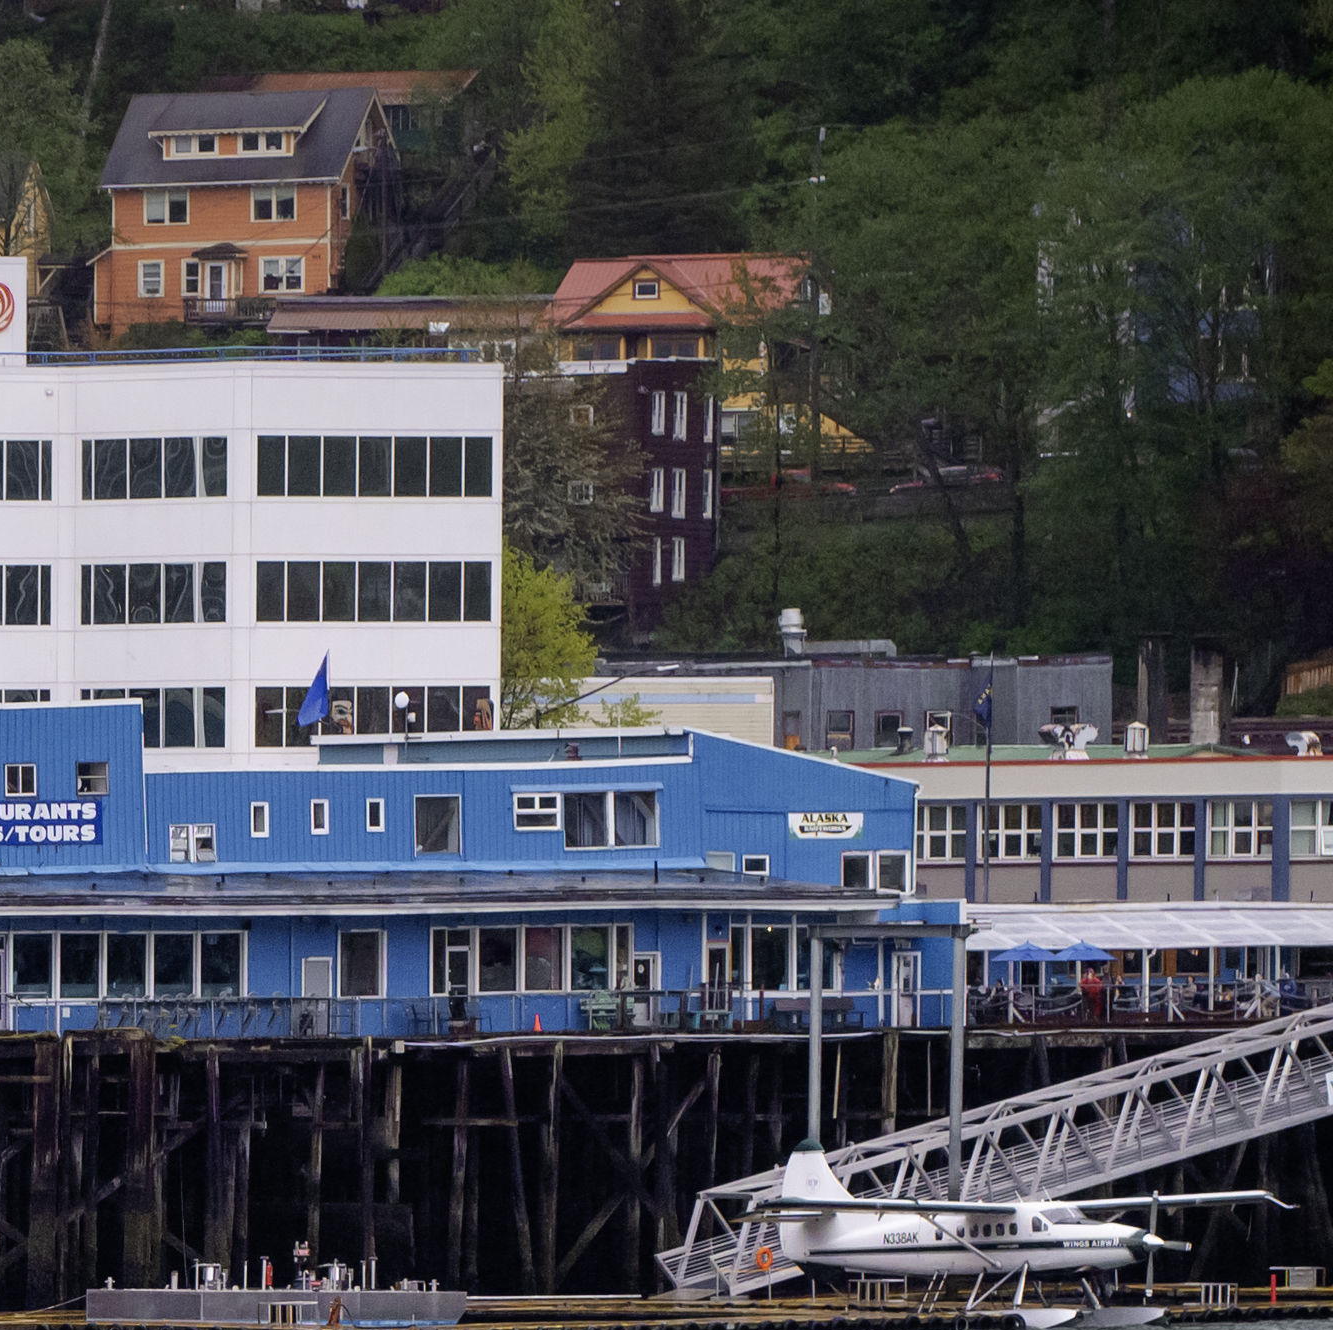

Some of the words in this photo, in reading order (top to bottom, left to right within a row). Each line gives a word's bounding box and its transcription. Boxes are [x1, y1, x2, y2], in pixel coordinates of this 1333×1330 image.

[801, 813, 849, 823] ALASKA
[883, 1231, 919, 1244] N338AK
[1063, 1240, 1090, 1248] WINGS
